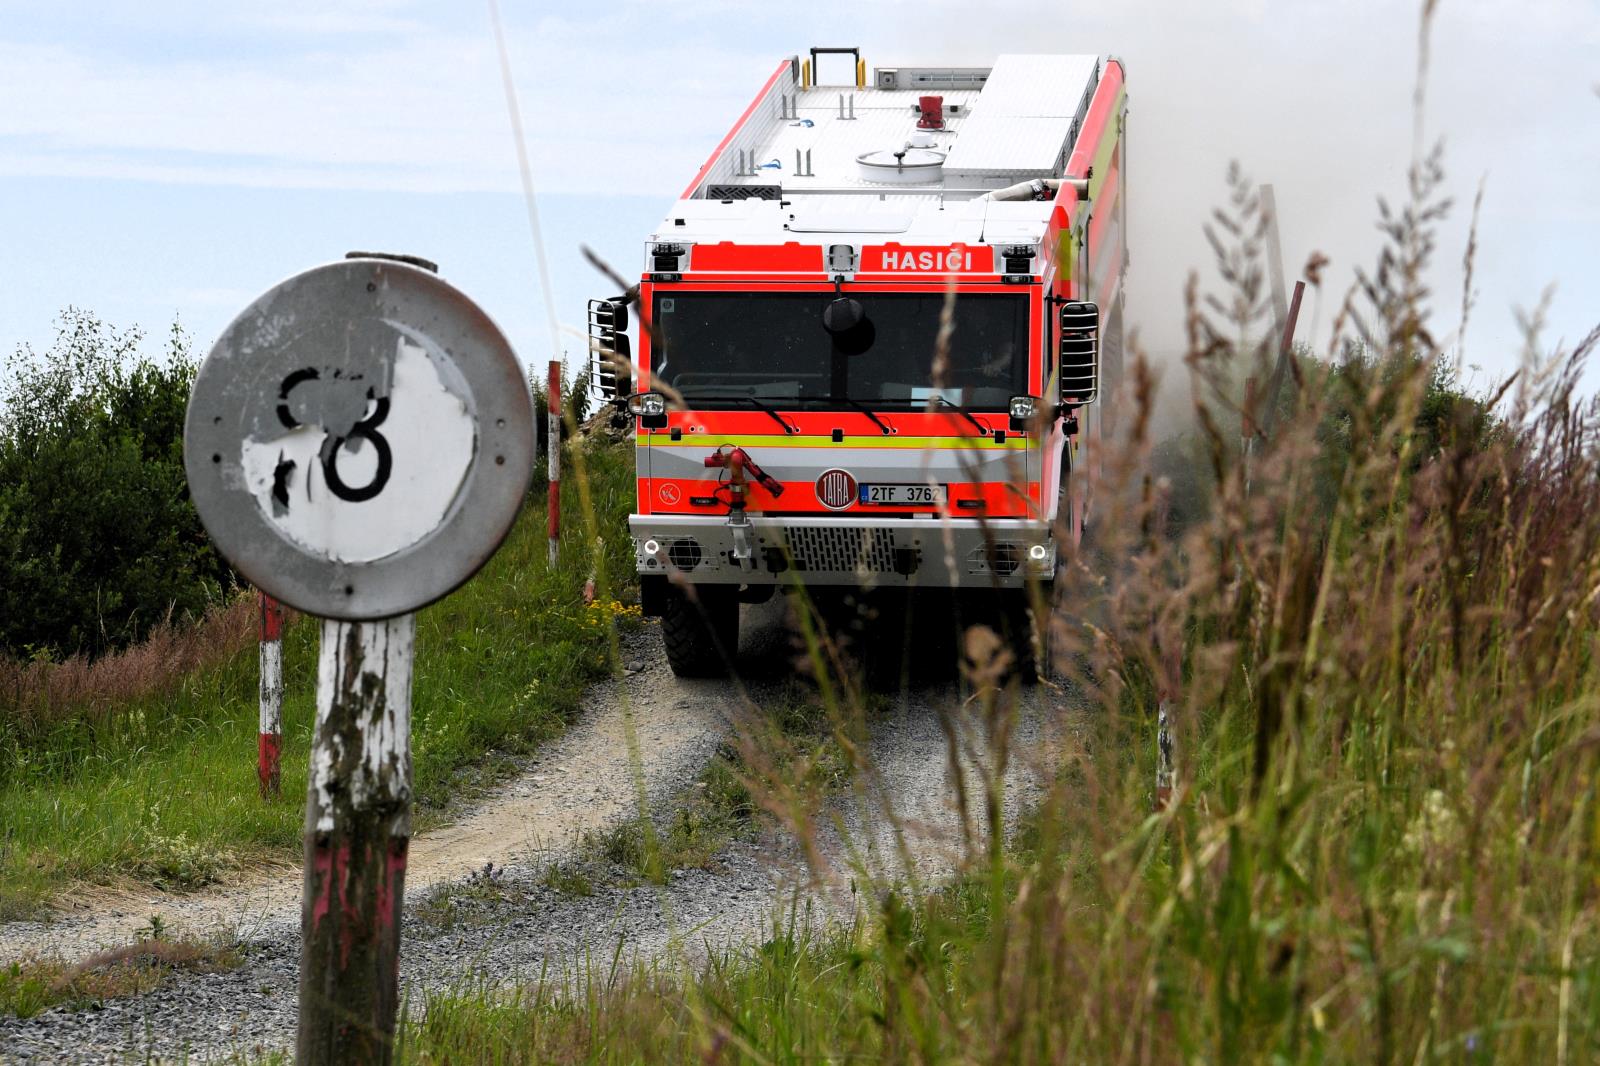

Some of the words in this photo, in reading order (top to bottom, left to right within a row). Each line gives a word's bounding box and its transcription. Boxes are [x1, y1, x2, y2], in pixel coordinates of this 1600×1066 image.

[882, 248, 972, 271] HASIČI
[823, 472, 849, 506] TATRA
[871, 487, 896, 501] 2TF
